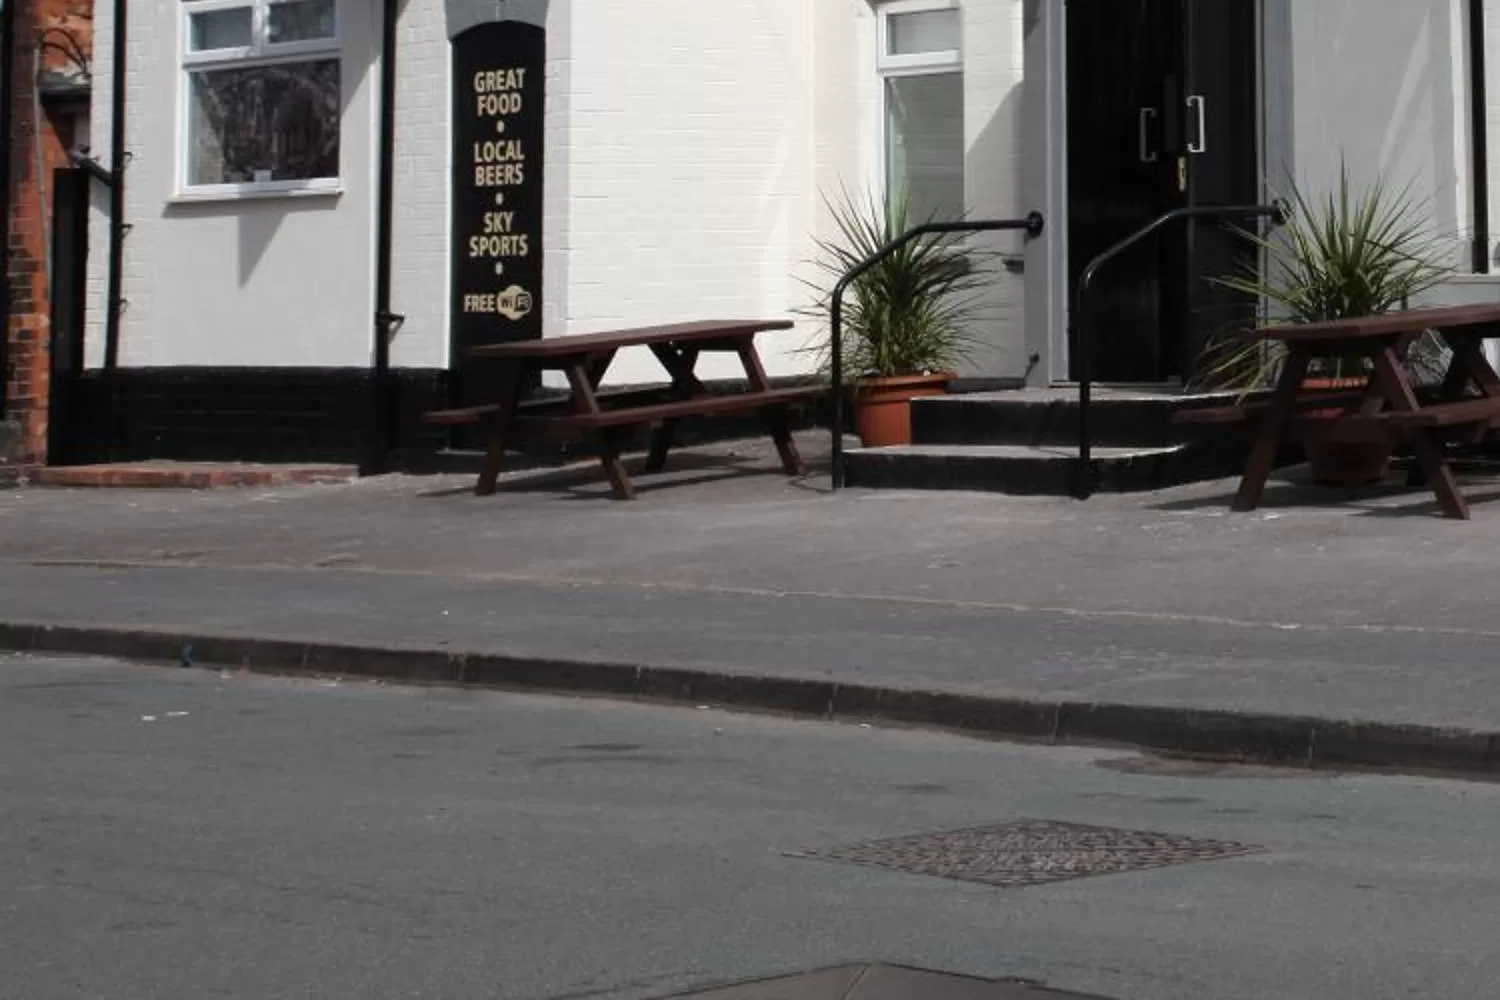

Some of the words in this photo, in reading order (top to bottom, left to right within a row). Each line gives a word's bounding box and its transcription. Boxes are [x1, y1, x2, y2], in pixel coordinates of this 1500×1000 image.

[473, 67, 526, 93] GREAT
[476, 92, 522, 117] FOOD
[474, 140, 524, 163] LOCAL
[475, 163, 524, 187] BEERS
[483, 211, 514, 234] SKY
[469, 234, 528, 258] SPORTS
[463, 293, 496, 313] FREE
